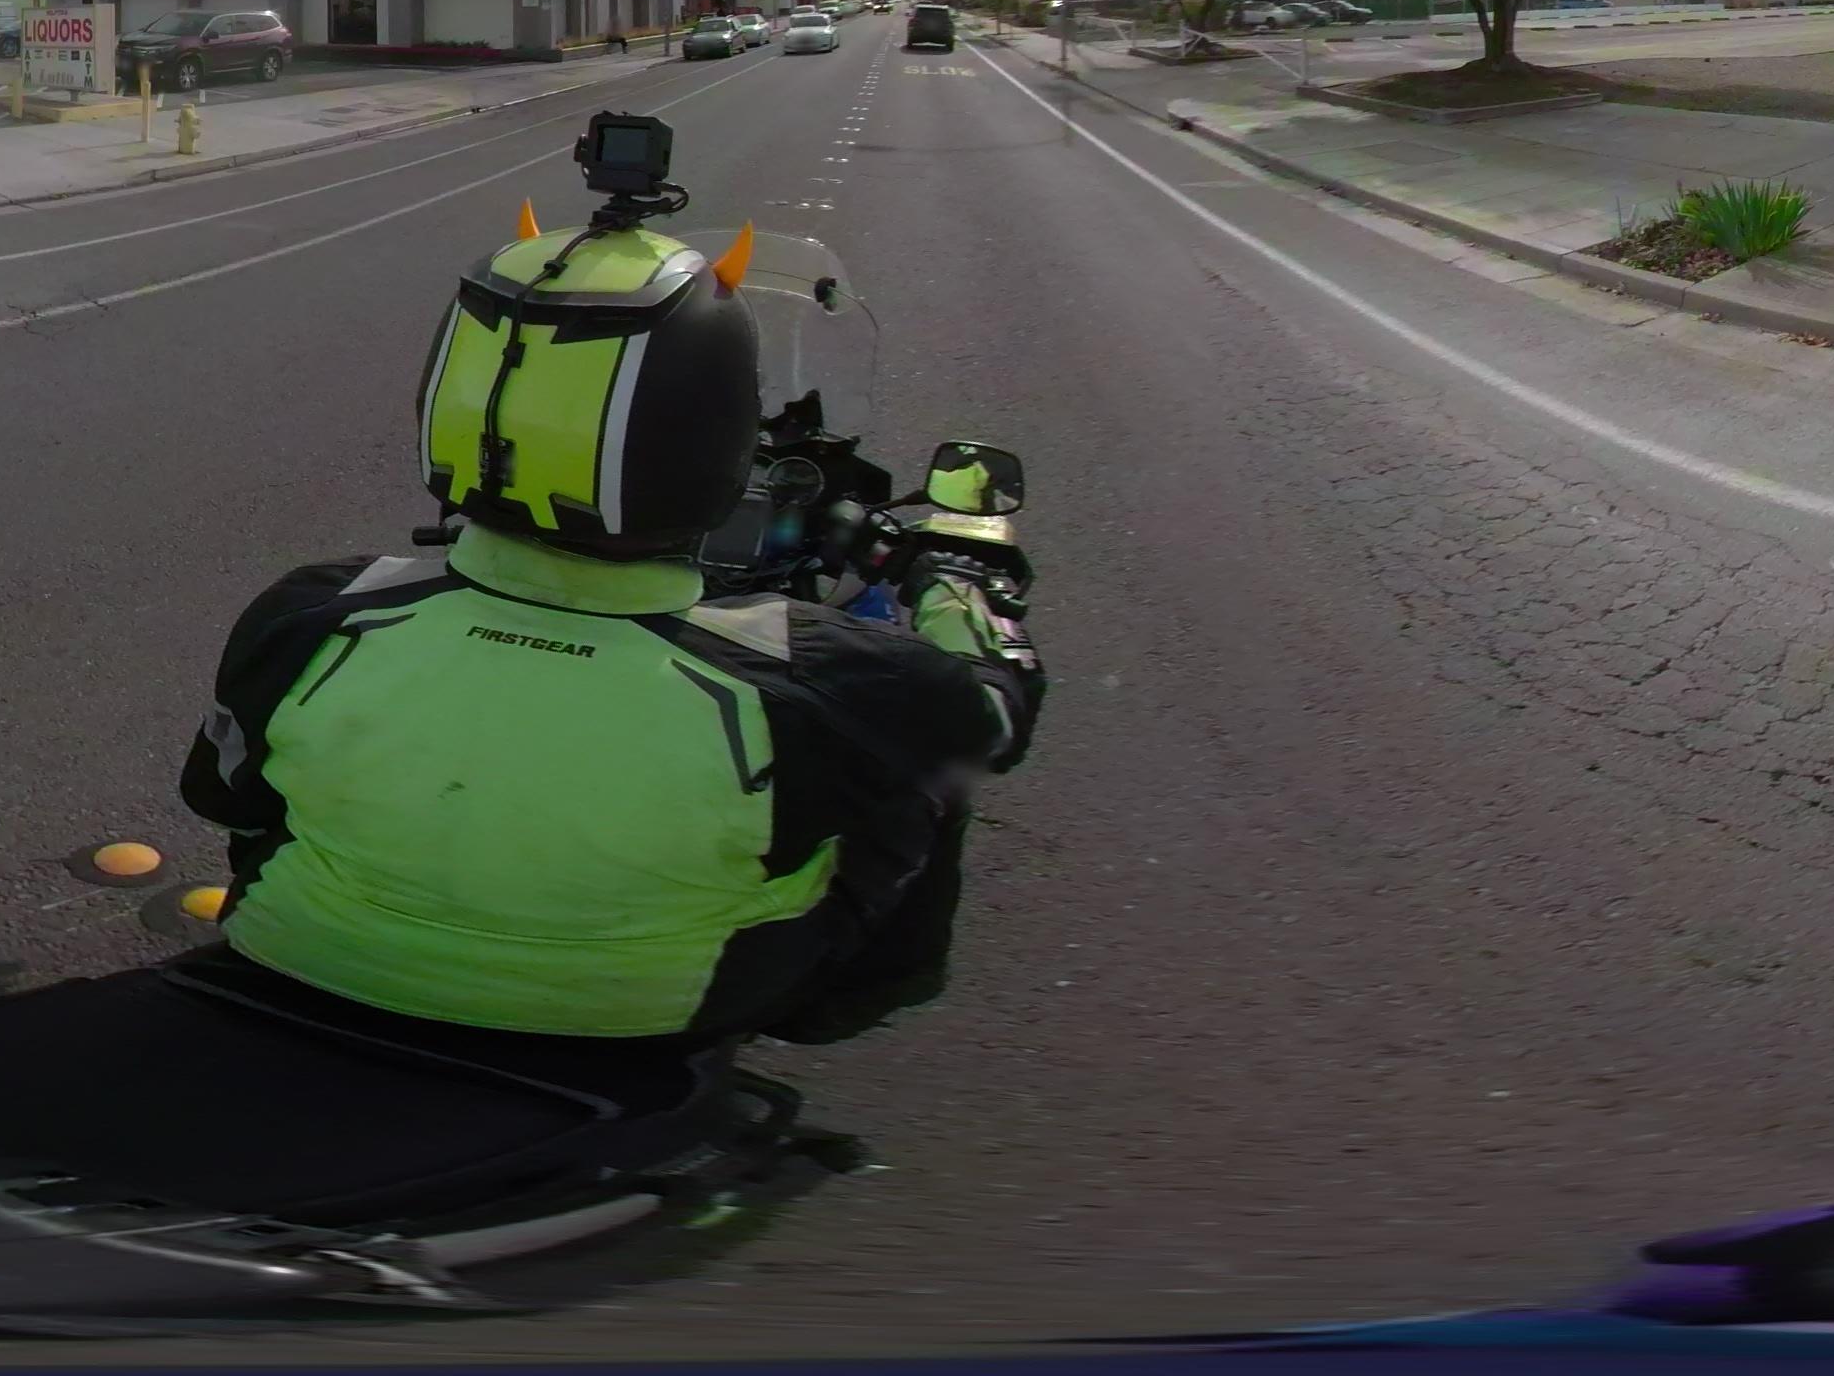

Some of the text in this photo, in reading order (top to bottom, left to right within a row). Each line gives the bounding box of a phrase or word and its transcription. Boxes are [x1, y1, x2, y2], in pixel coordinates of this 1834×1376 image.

[24, 18, 93, 43] LIQUORS
[84, 50, 93, 89] ATM
[466, 626, 596, 658] FIRSTGEAR
